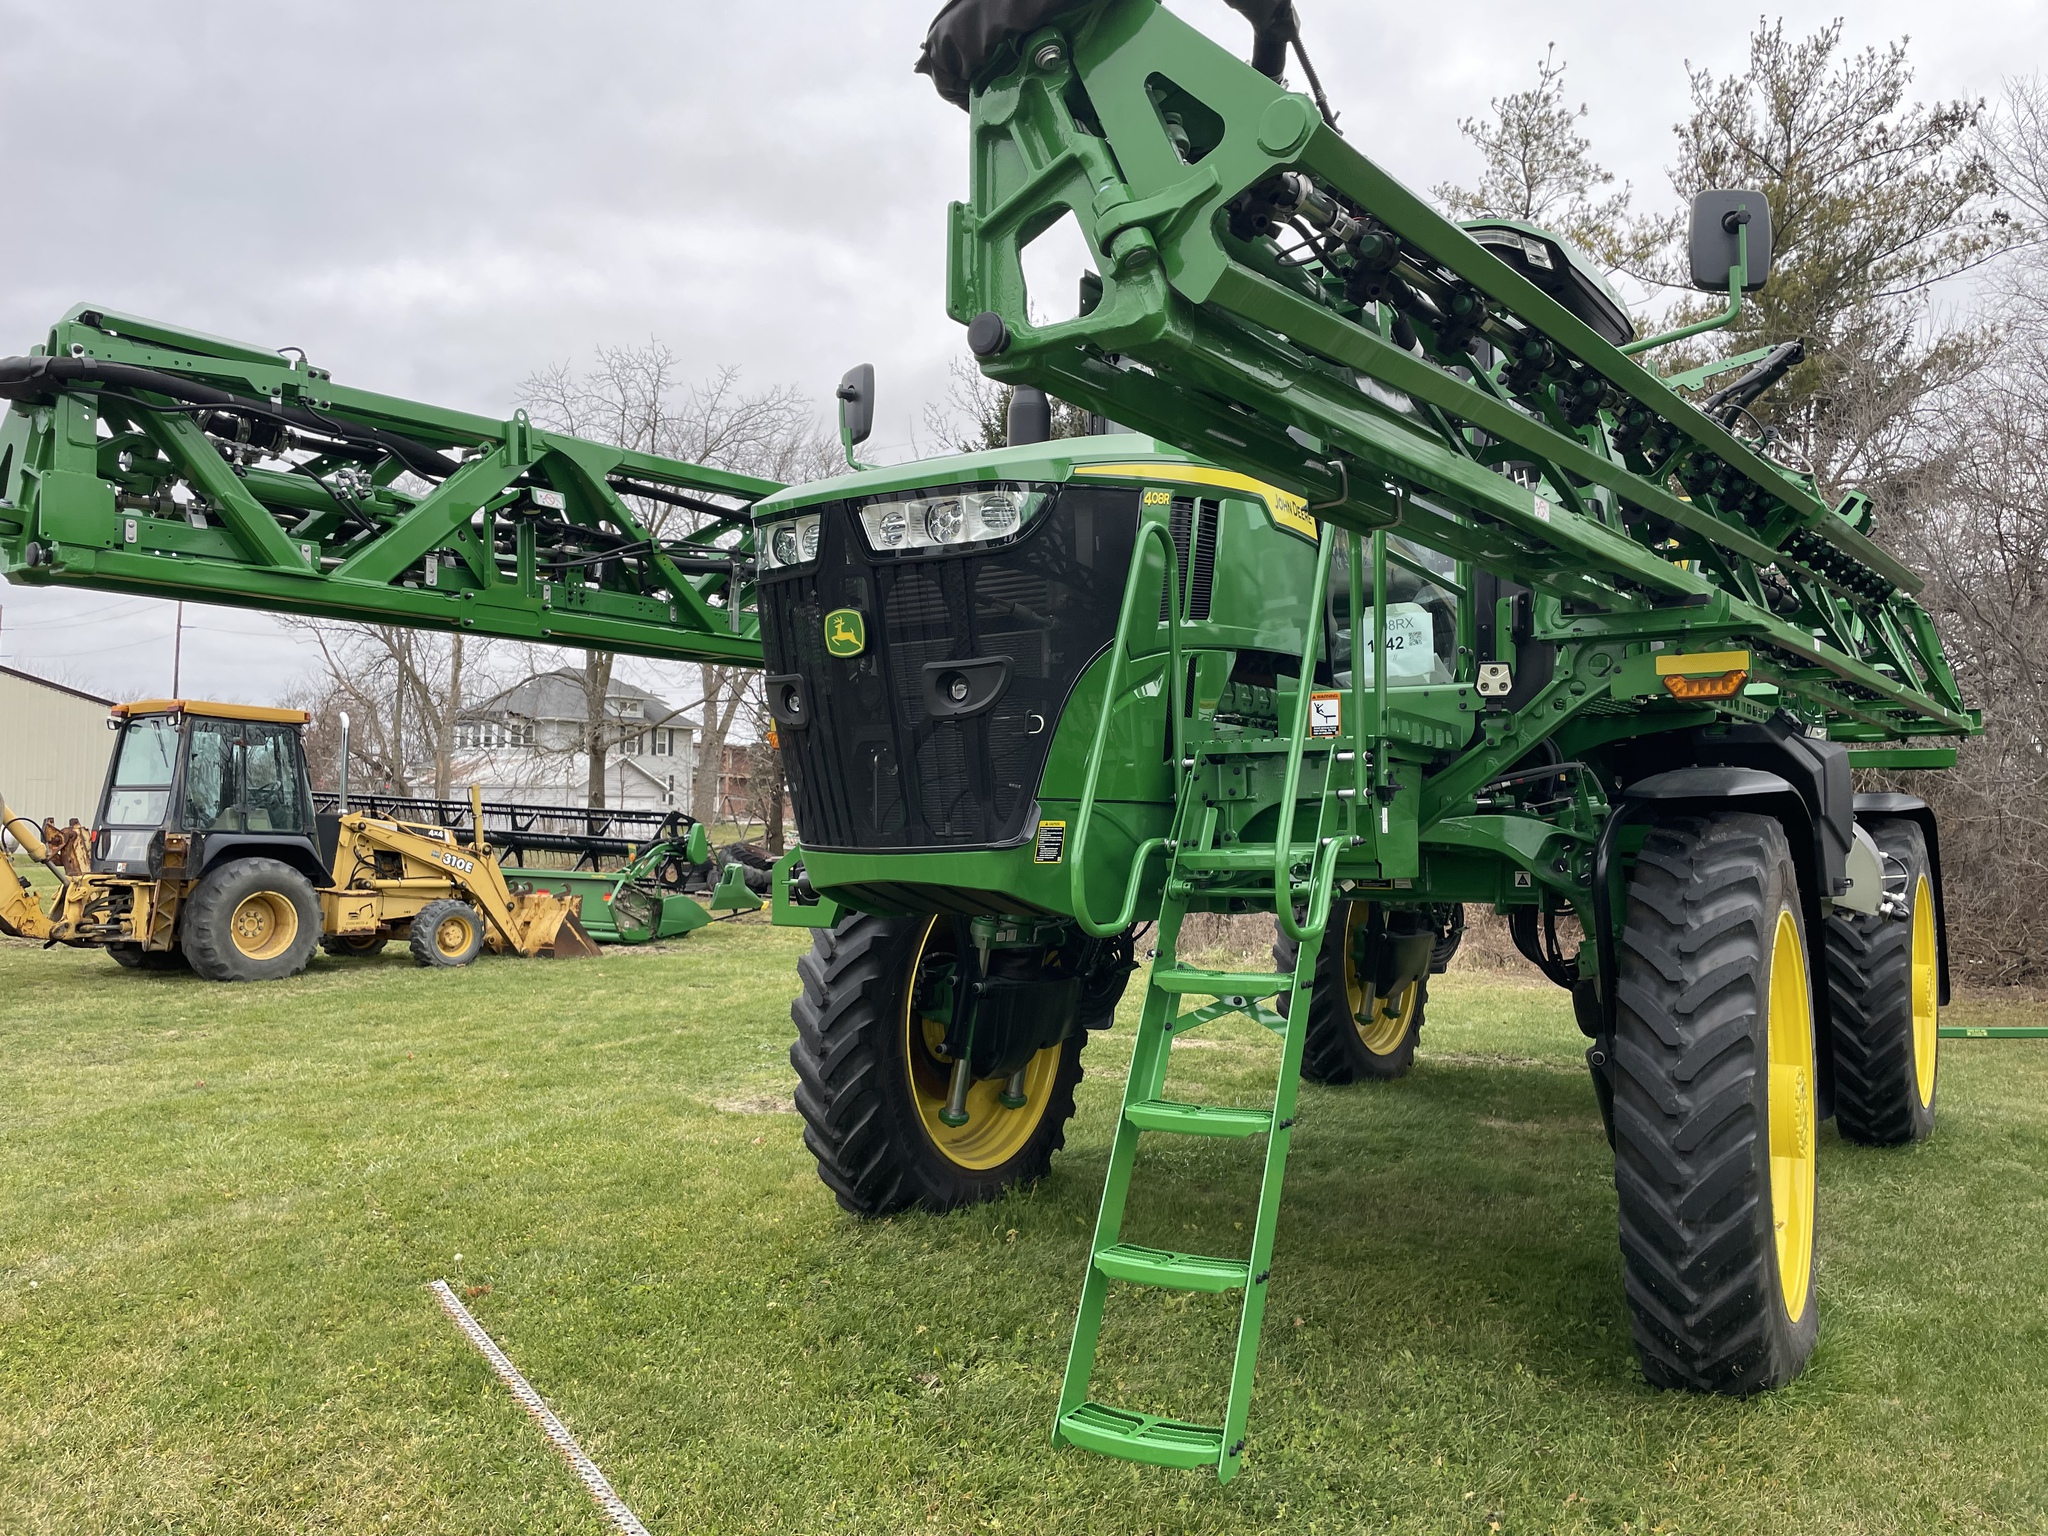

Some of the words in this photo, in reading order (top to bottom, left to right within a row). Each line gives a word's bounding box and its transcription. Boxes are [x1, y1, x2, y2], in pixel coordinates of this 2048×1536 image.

[1143, 491, 1170, 507] 408R
[1274, 493, 1293, 515] JOHN
[1291, 500, 1313, 526] DEERE
[1367, 636, 1405, 653] 142
[442, 852, 474, 874] 310E
